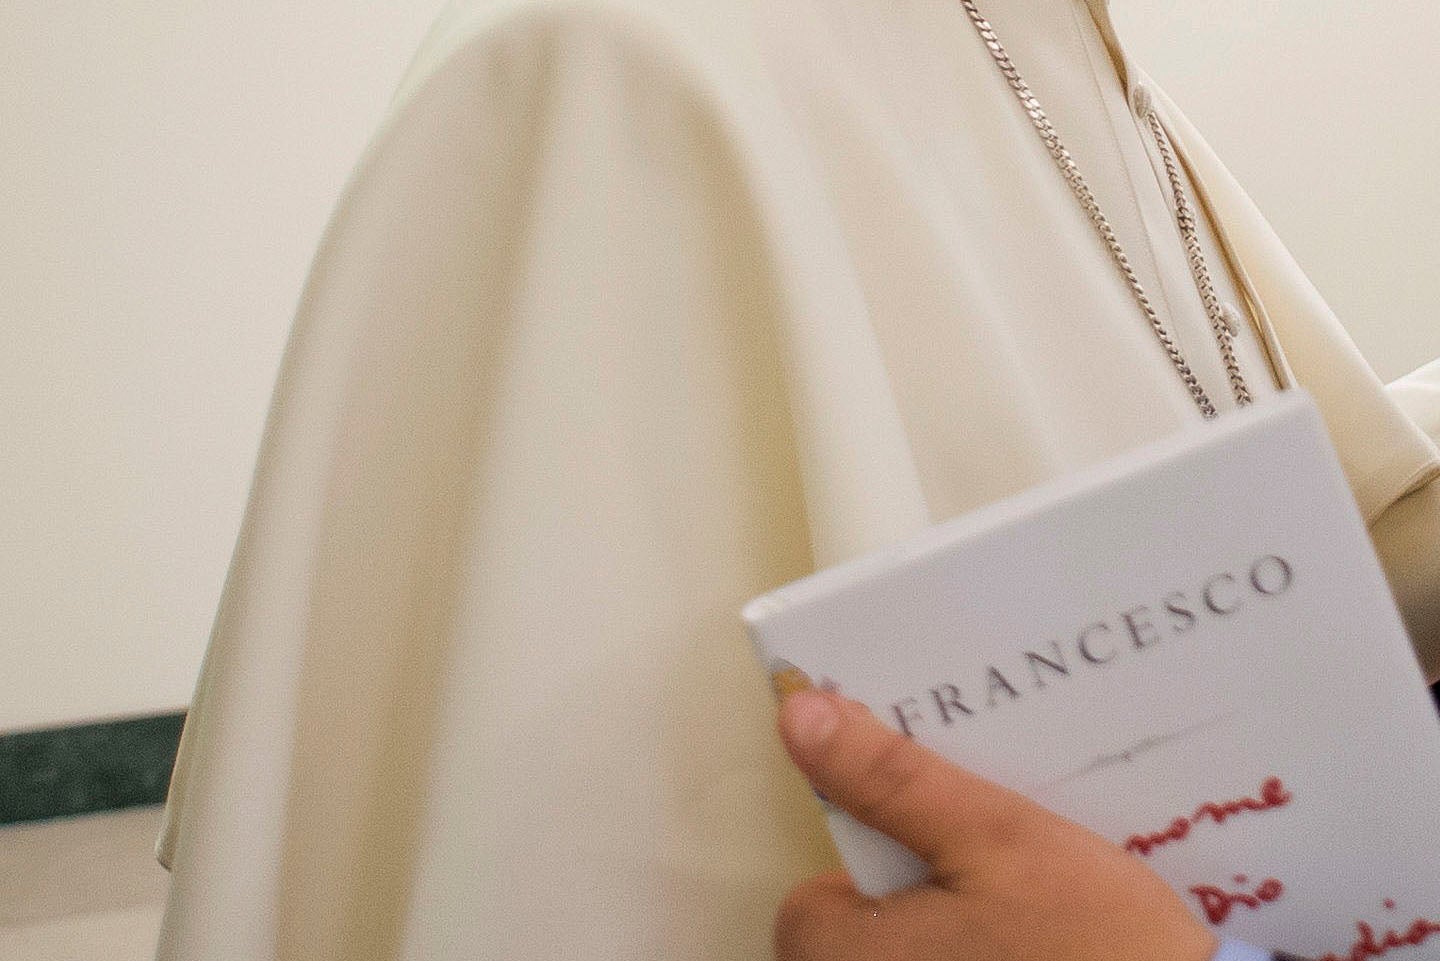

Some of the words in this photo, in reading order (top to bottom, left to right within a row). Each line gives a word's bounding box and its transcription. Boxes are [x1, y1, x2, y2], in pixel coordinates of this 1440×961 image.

[889, 554, 1294, 738] FRANCESCO
[1125, 776, 1293, 856] nome
[1190, 874, 1285, 926] Dio
